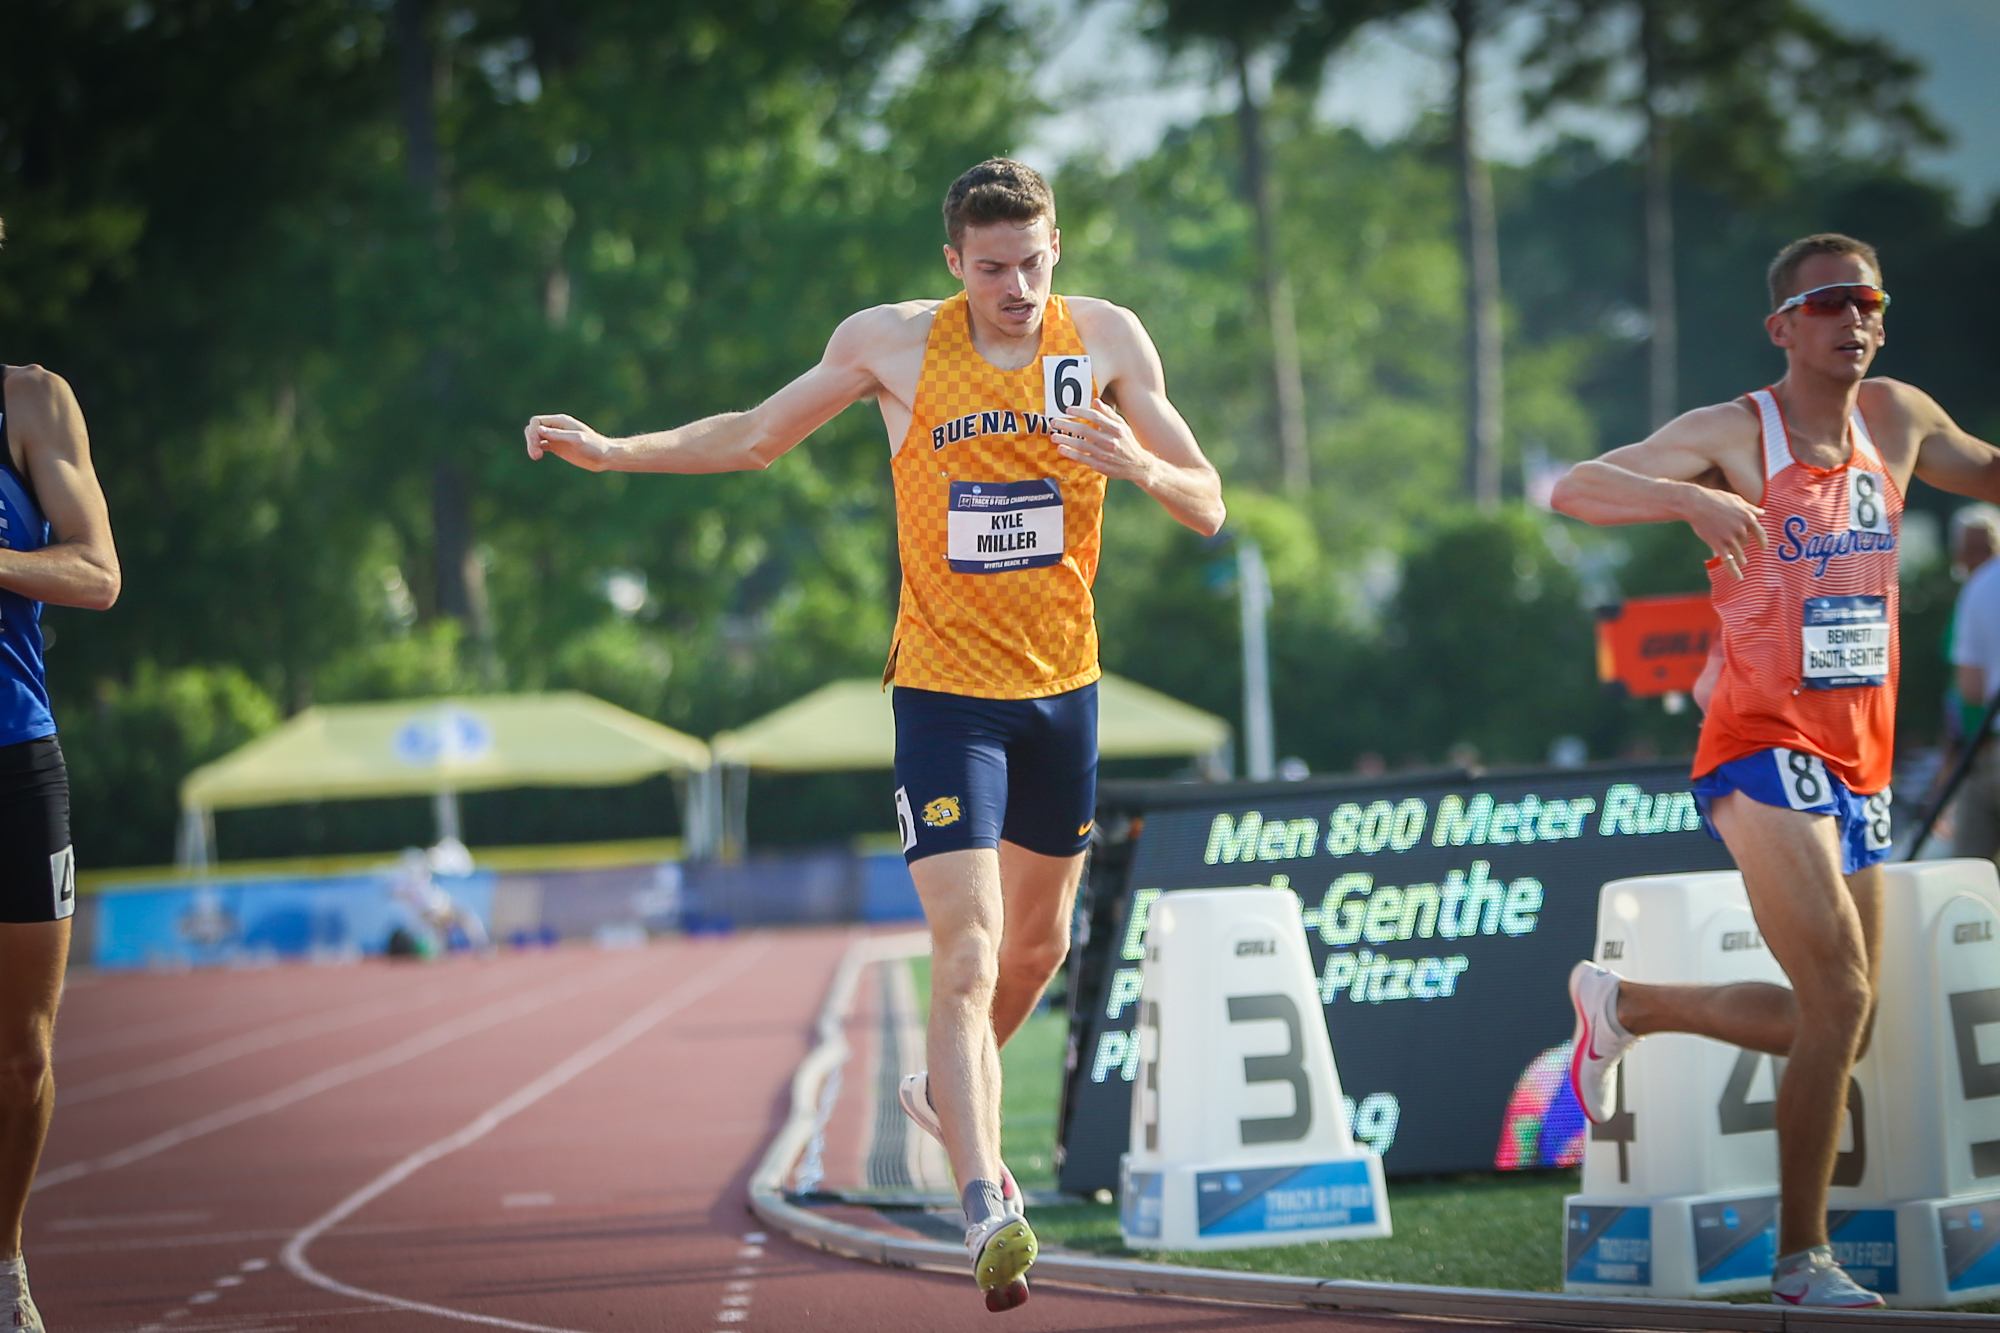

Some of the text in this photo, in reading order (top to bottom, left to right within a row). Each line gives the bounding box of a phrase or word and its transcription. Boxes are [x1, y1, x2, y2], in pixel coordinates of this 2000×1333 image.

[1053, 358, 1083, 414] 6
[931, 410, 1019, 452] BUENA
[991, 512, 1023, 530] KYLE
[1856, 473, 1878, 529] 8
[977, 531, 1037, 553] MILLER
[1828, 628, 1872, 644] BENNETT
[1788, 750, 1821, 804] 8
[1204, 783, 1702, 865] Men 800 Meter Run
[1871, 788, 1892, 844] 8
[60, 853, 73, 902] 4
[1603, 941, 1624, 960] GILL
[1953, 920, 1994, 944] GILL
[1226, 993, 1315, 1146] 3
